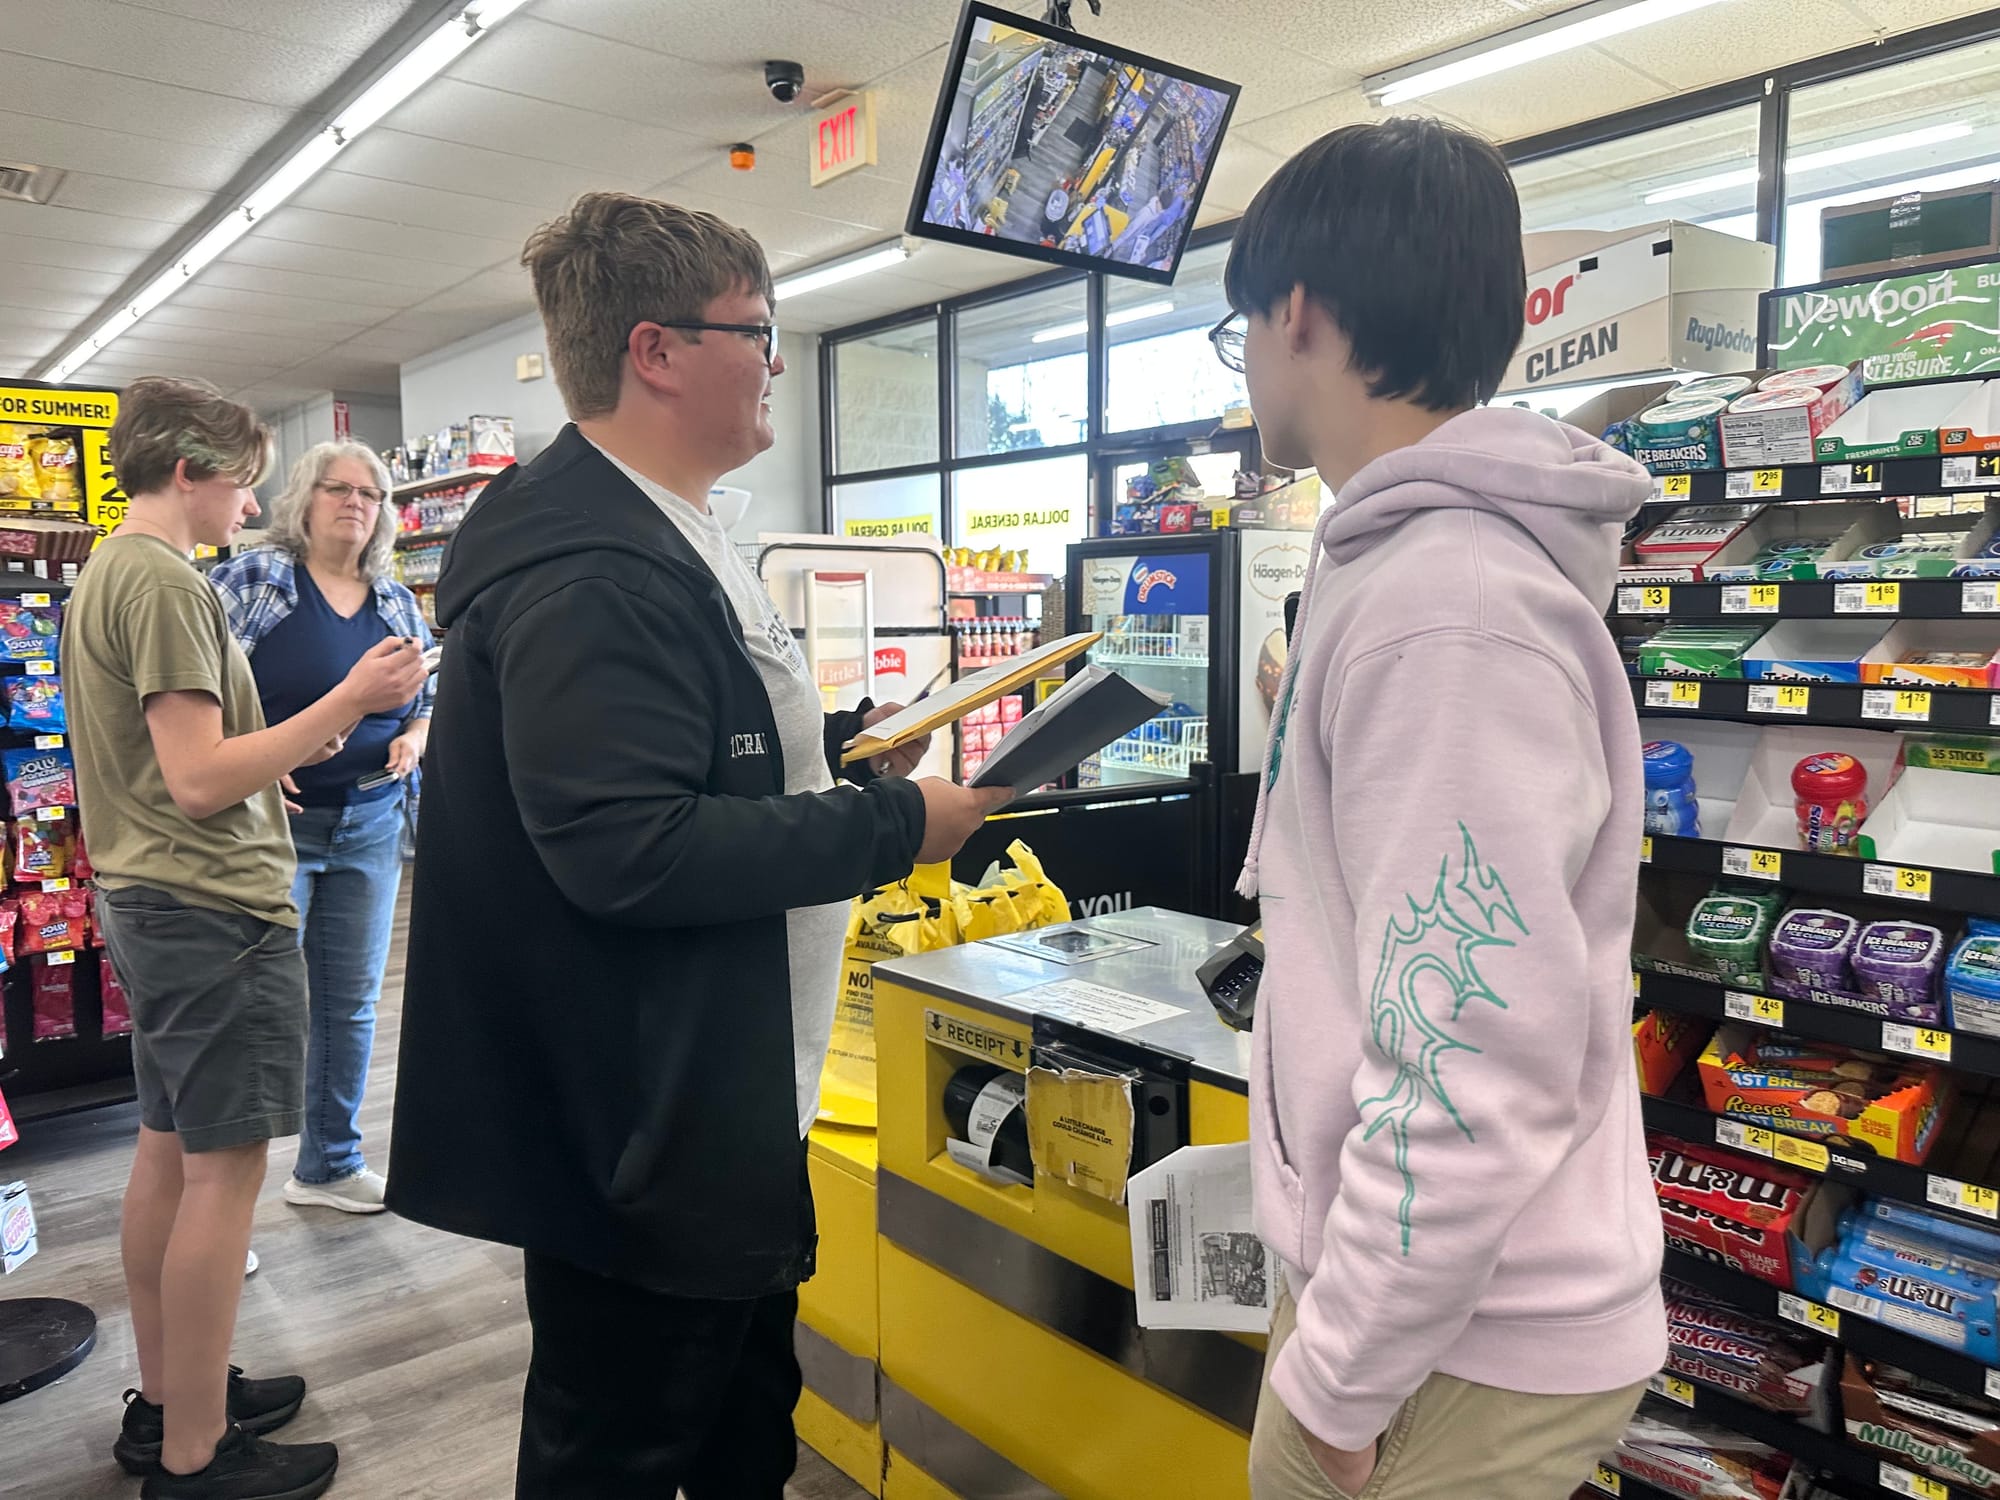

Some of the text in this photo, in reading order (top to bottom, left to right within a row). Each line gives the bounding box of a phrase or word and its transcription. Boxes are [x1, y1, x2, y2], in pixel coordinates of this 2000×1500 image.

[819, 105, 857, 171] EXIT
[1785, 274, 1957, 328] Newport
[1526, 322, 1618, 383] CLEAN
[0, 397, 110, 419] OR SUMMER!
[1652, 443, 1707, 462] BREAKERS
[1845, 445, 1900, 460] FRESHMINTS
[1655, 461, 1687, 471] MINTS
[1855, 464, 1873, 482] $1
[1655, 527, 1729, 538] ALTOIDS
[1137, 569, 1178, 603] DRUMSTICK
[1648, 589, 1663, 604] $3
[11, 639, 44, 650] JOLLY
[820, 666, 856, 683] Little
[1932, 749, 1985, 762] 35 STICKS
[20, 757, 58, 775] JOLLY
[1078, 891, 1132, 918] YOU
[40, 921, 68, 936] JOLLY
[1670, 964, 1722, 984] BREAKERS
[1811, 989, 1889, 1016] ICE BREAKERS
[947, 1024, 1006, 1056] RECEIPT
[1725, 1095, 1792, 1118] Reese's
[1773, 1118, 1835, 1135] BREAK
[1739, 1249, 1781, 1269] SHARE
[1749, 1259, 1776, 1275] SIZE
[1859, 1423, 1992, 1488] Milky Way
